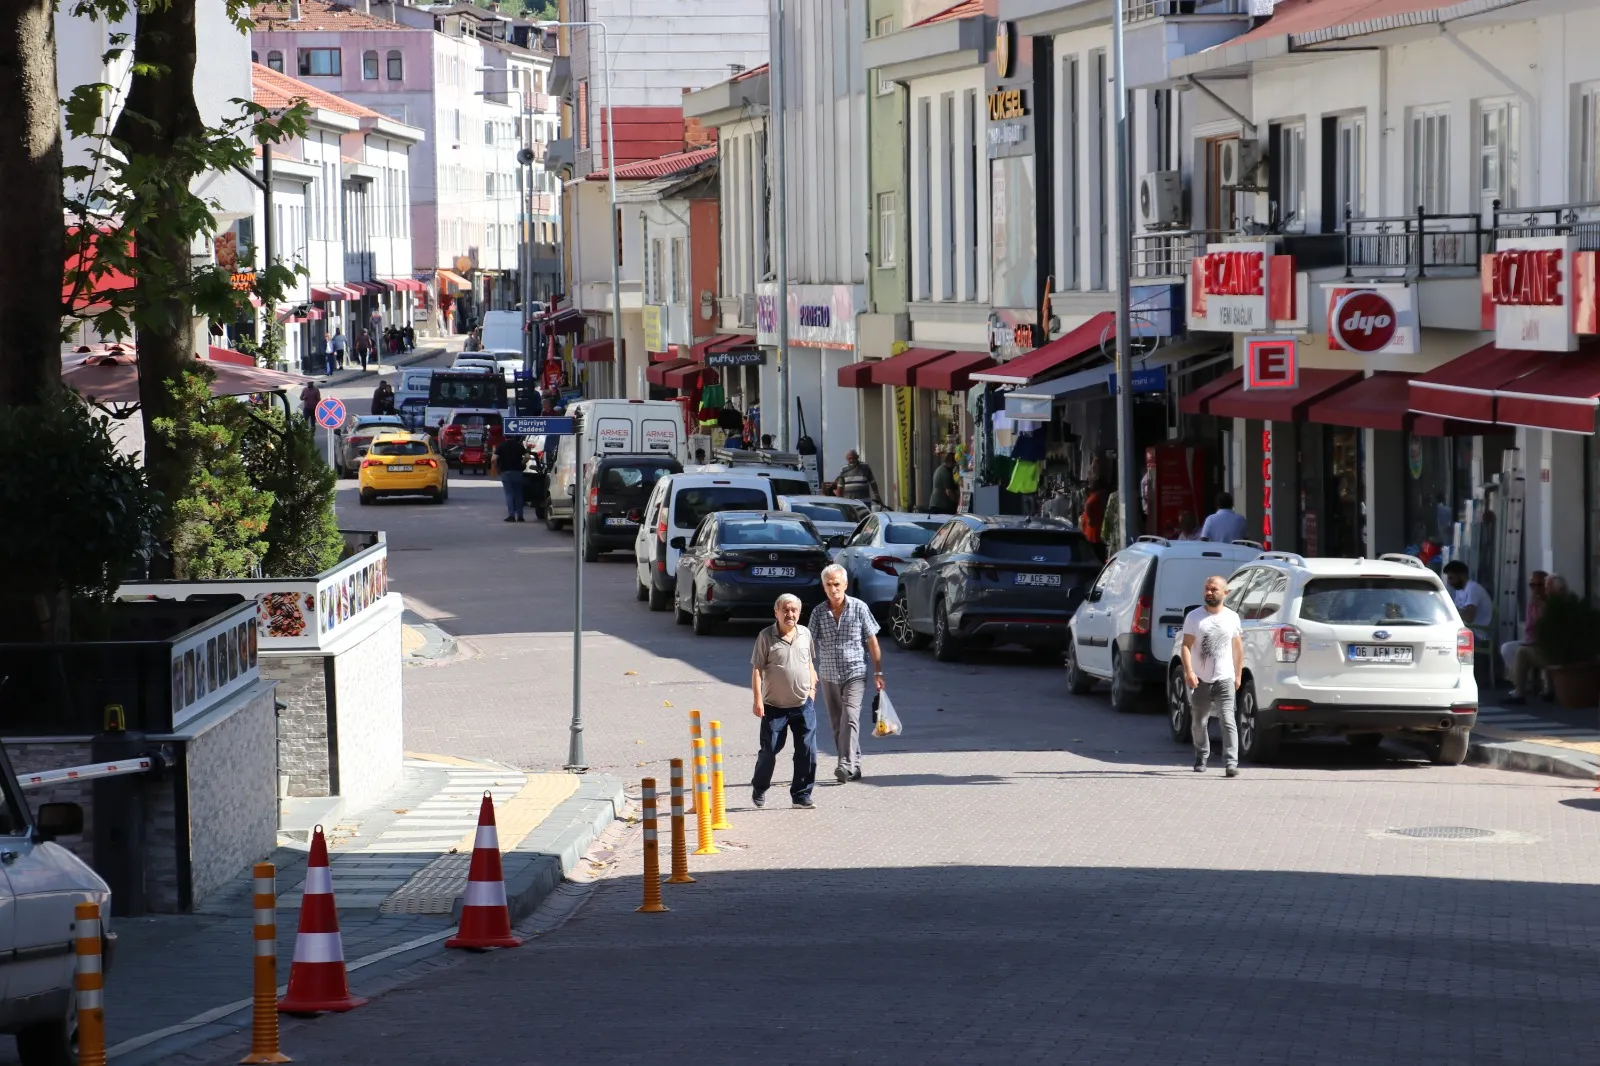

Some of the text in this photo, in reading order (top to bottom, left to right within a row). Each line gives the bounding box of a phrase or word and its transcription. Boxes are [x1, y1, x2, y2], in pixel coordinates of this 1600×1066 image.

[988, 85, 1025, 121] YÜKSEL
[1204, 251, 1264, 295] ECZANE
[1491, 249, 1563, 305] ECZANE
[1343, 310, 1391, 336] dyo
[709, 353, 761, 364] puffy yatak
[1259, 347, 1286, 379] E
[600, 429, 629, 437] ARMES
[645, 430, 675, 439] ARMES
[755, 567, 795, 576] 37 AS 792
[1356, 646, 1367, 657] 06
[1394, 647, 1412, 659] 577
